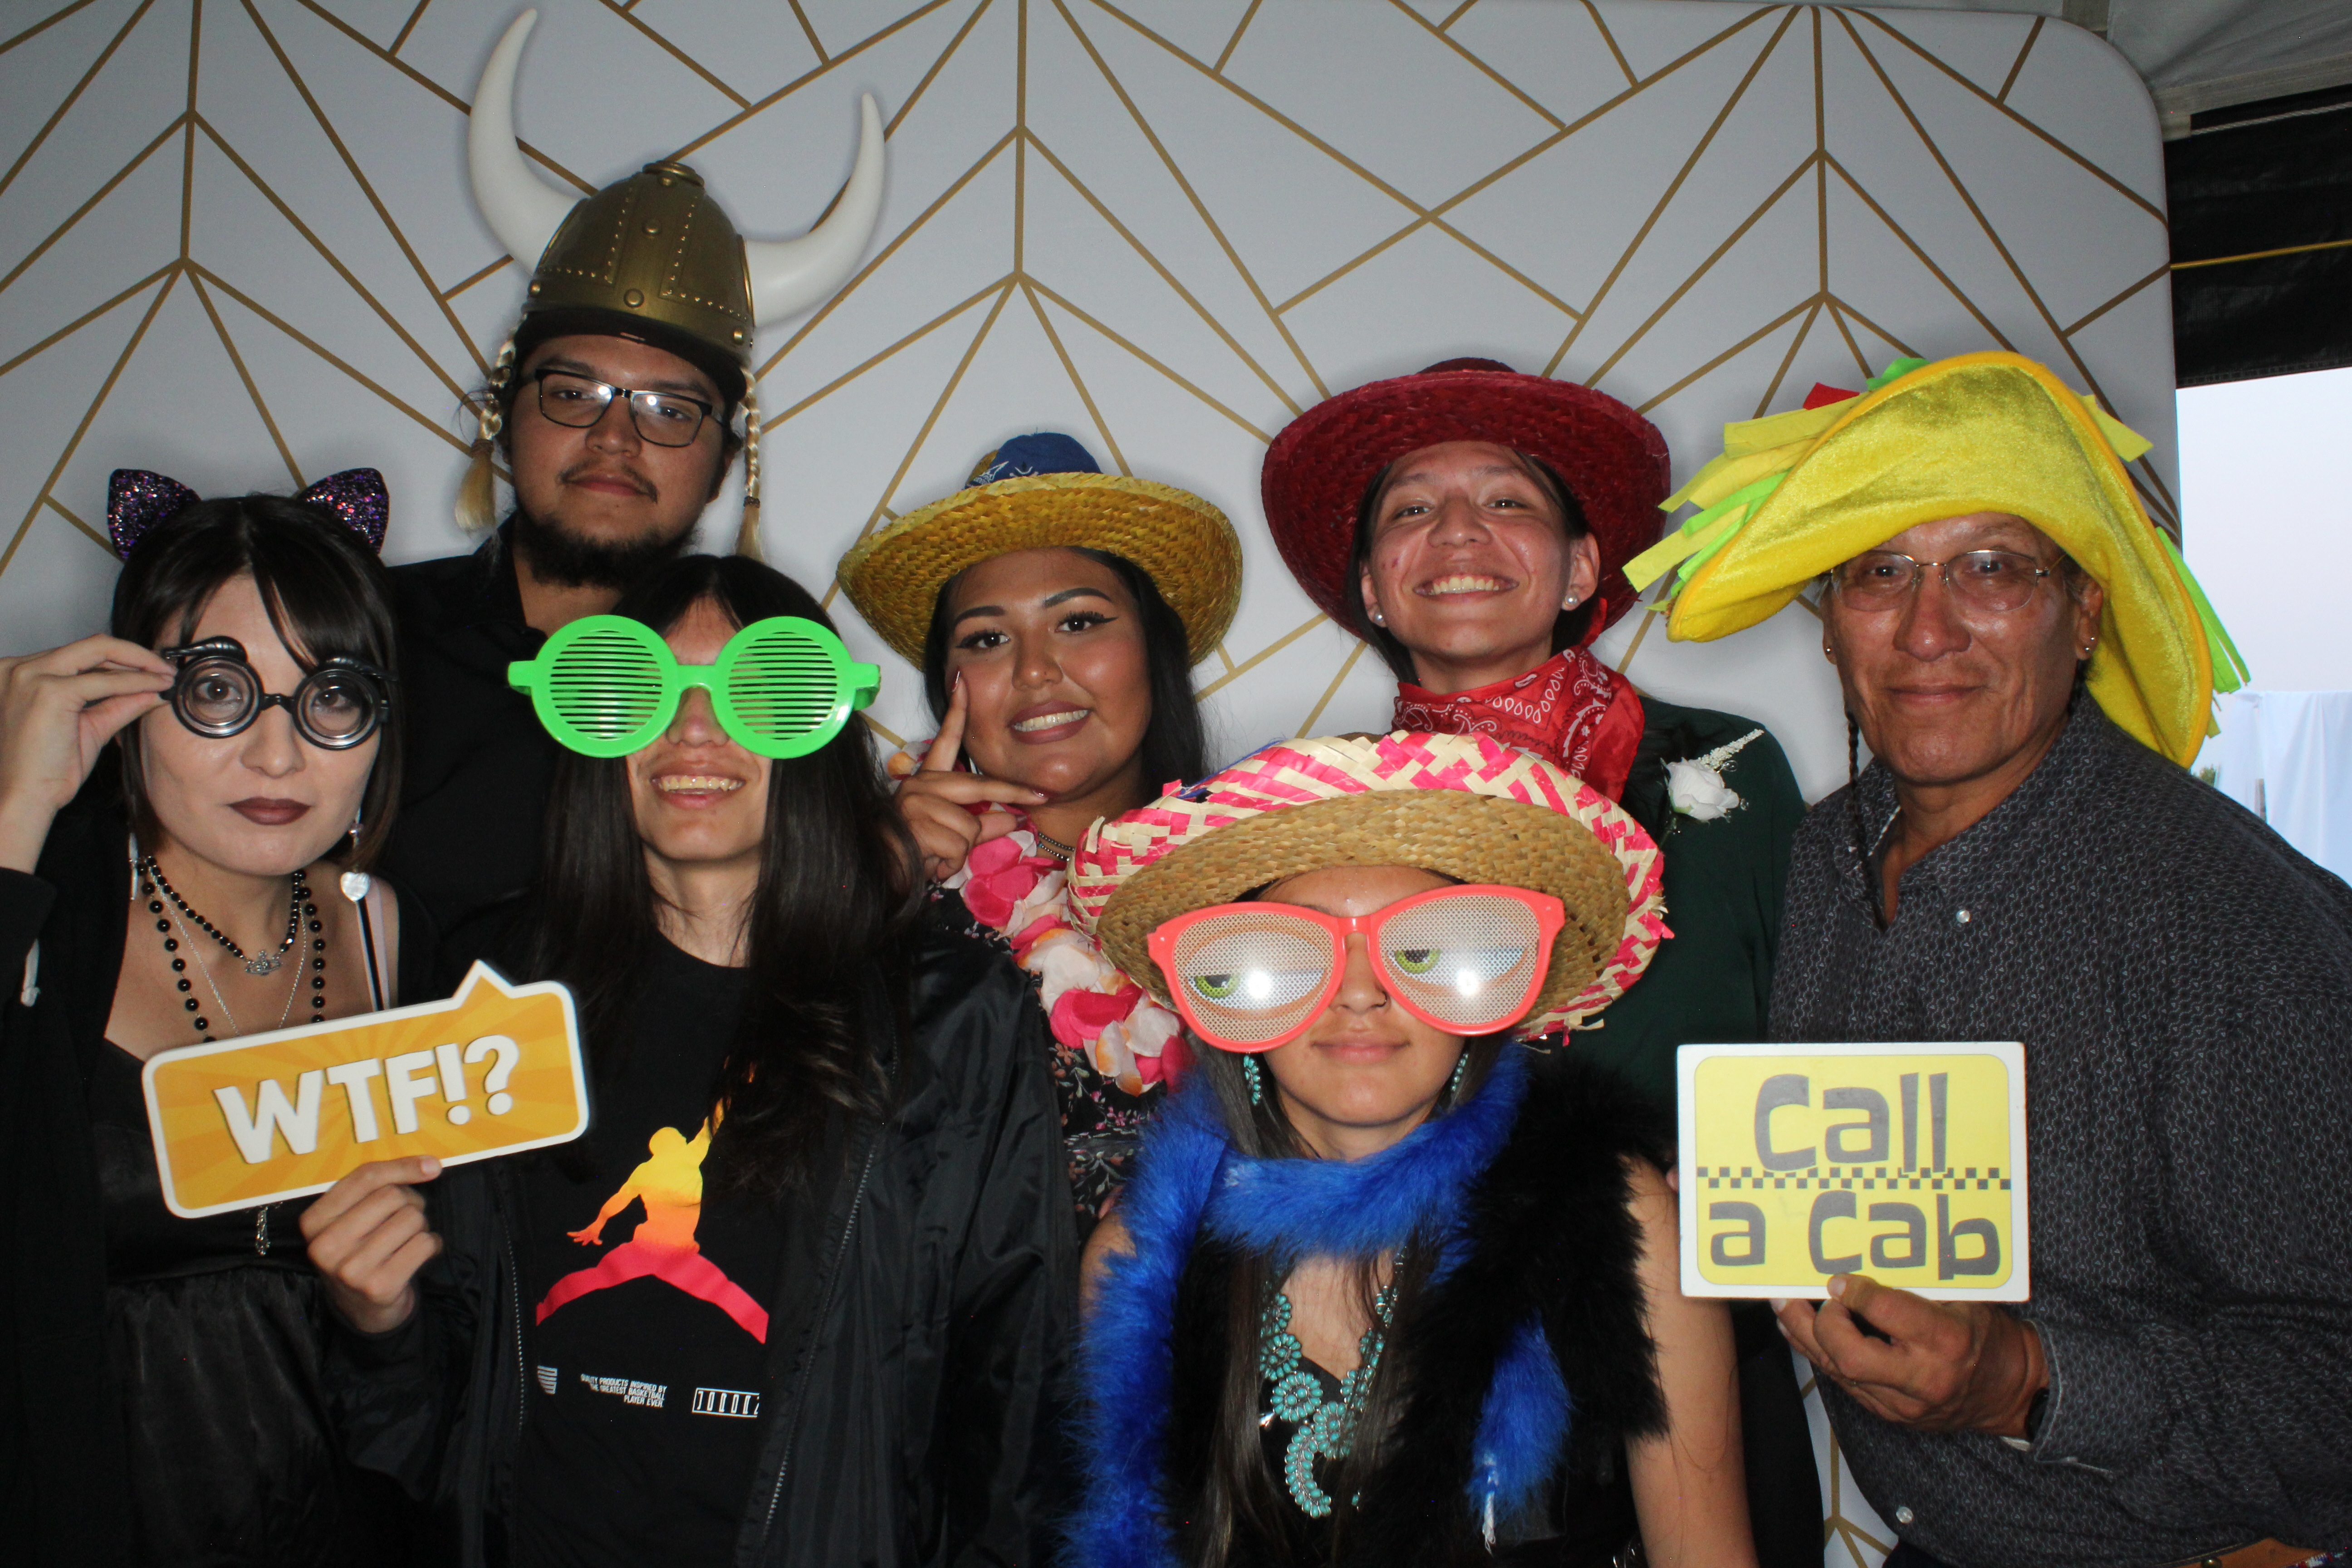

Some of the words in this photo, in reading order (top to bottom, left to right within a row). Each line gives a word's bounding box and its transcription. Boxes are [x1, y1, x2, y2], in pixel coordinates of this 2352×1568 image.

[213, 1034, 519, 1164] WTF!?
[1754, 1072, 1948, 1172] Call
[1709, 1201, 1765, 1266] a
[1808, 1190, 2001, 1280] Cab
[599, 1377, 629, 1387] PRODUCTS
[630, 1381, 657, 1392] INSPIRED
[658, 1385, 667, 1393] BY
[624, 1394, 645, 1405] PLAYER
[628, 1387, 665, 1401] BASKETBALL
